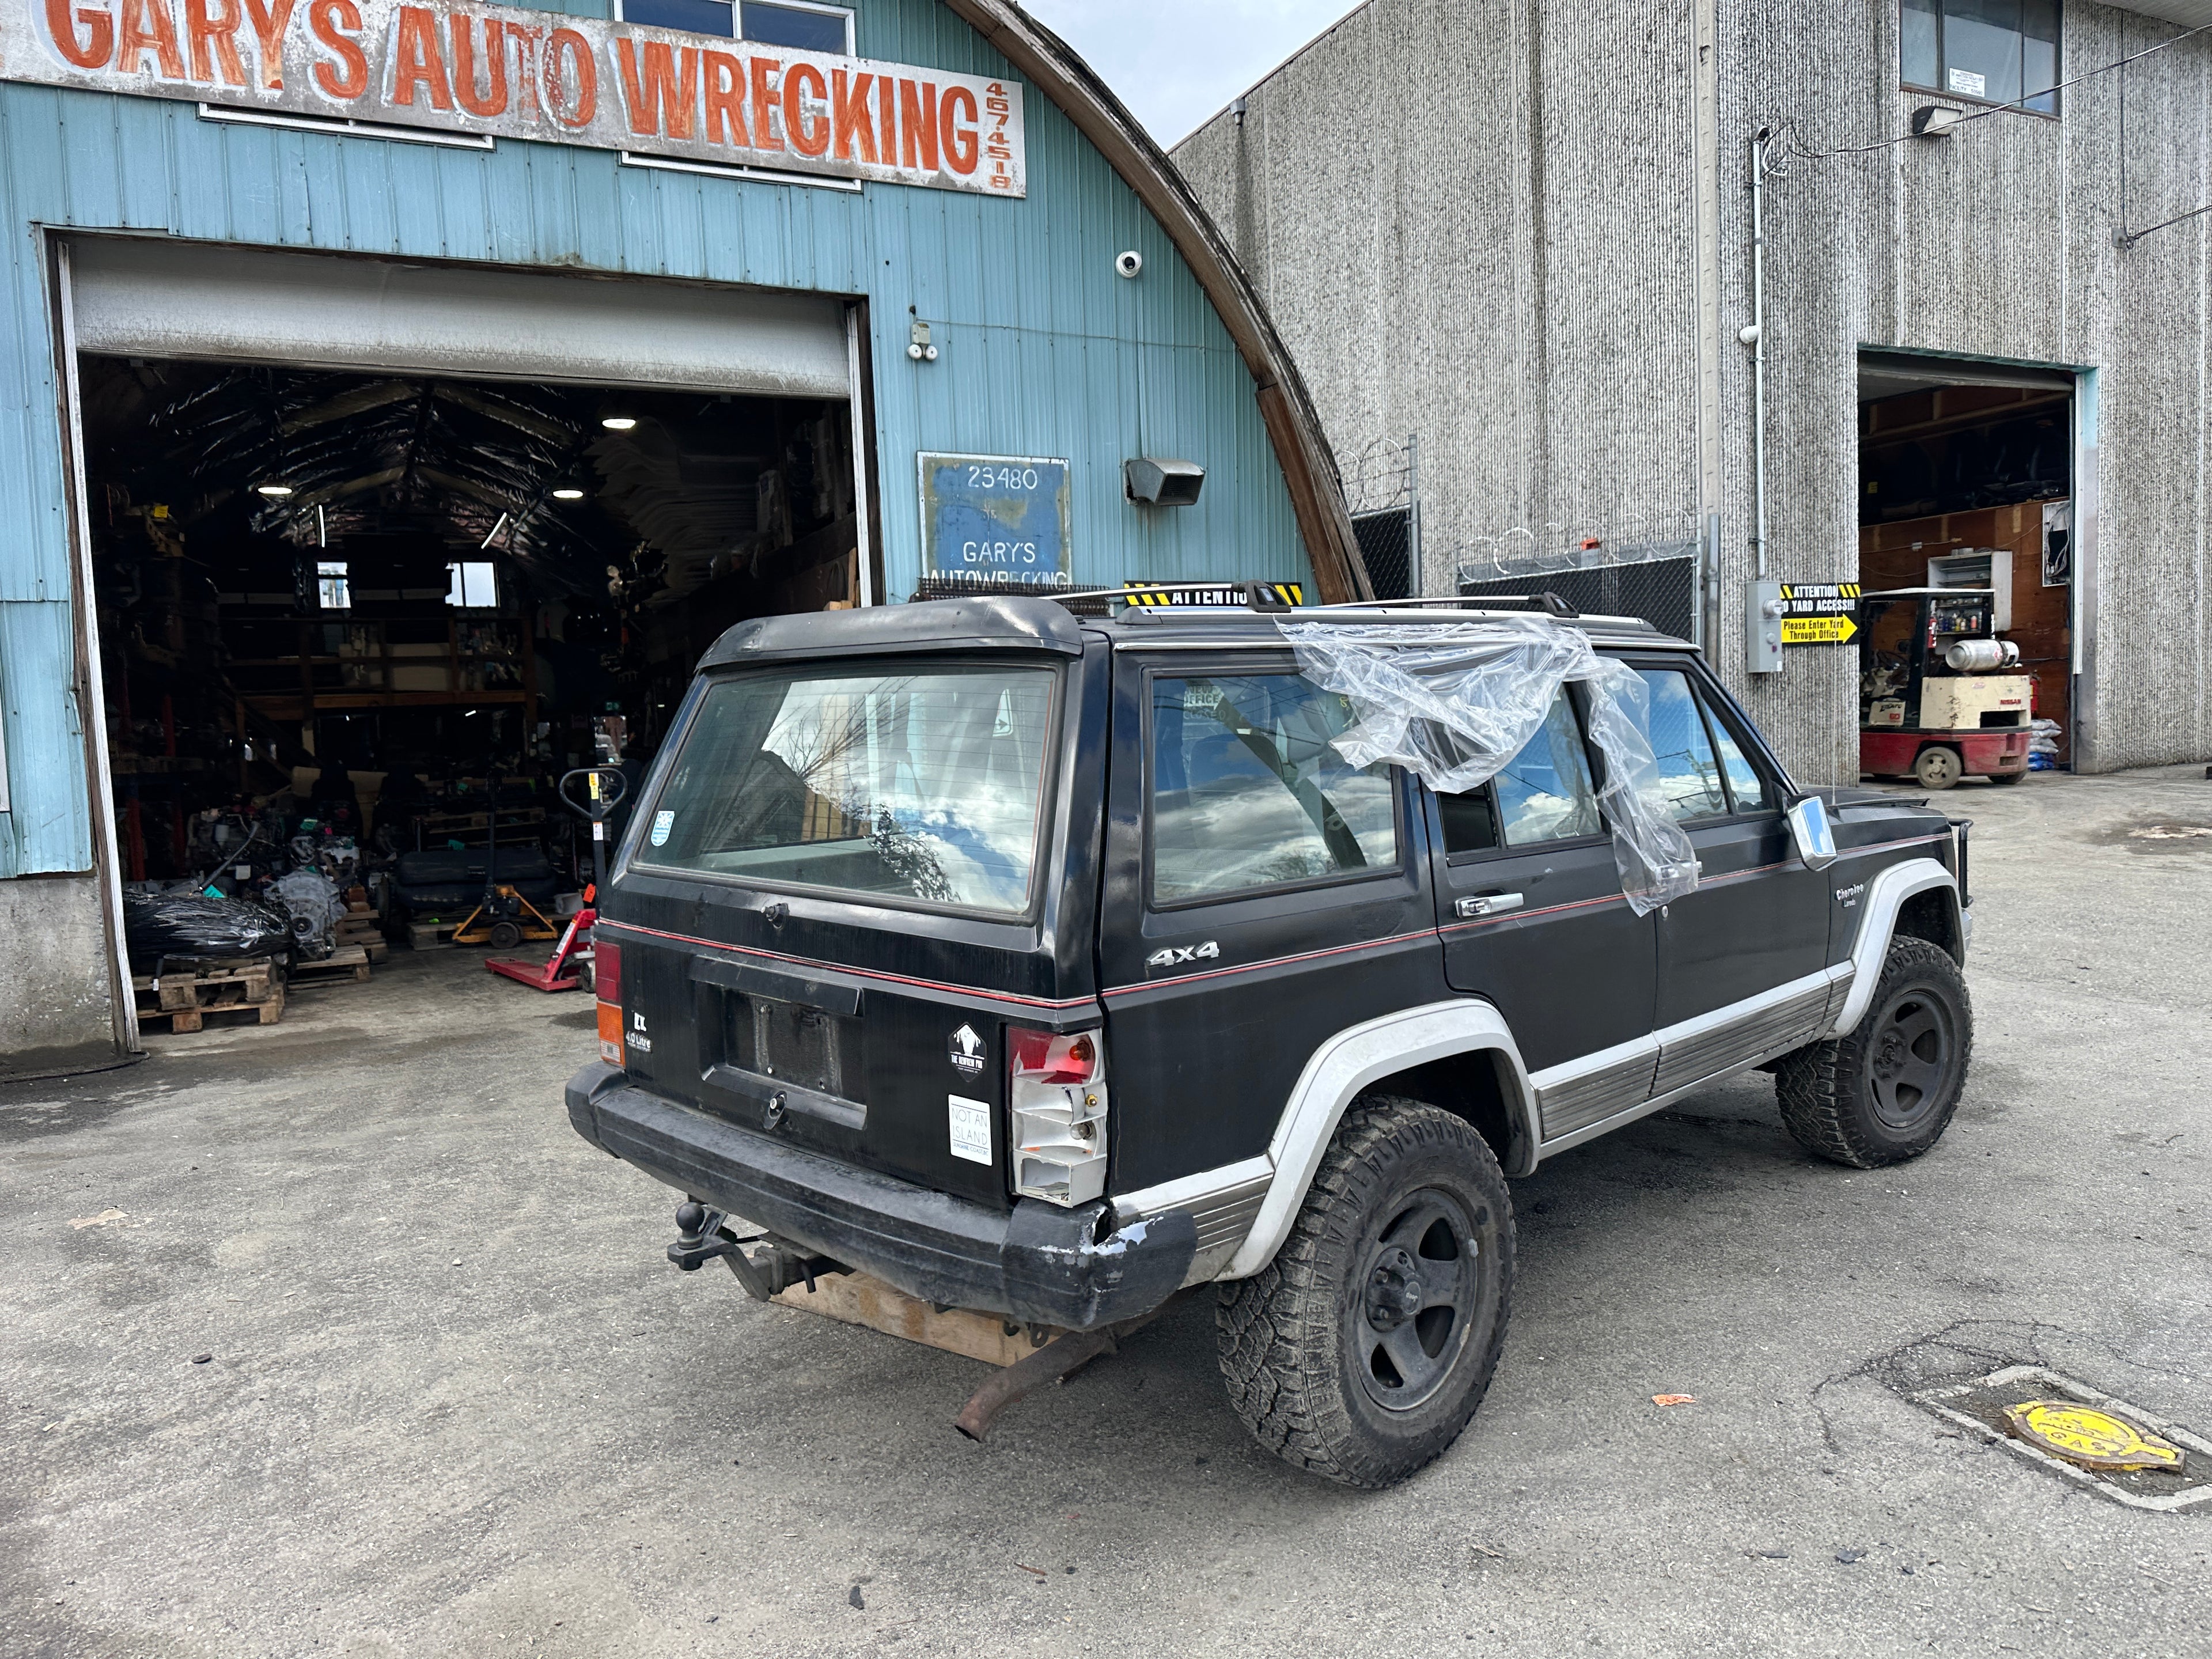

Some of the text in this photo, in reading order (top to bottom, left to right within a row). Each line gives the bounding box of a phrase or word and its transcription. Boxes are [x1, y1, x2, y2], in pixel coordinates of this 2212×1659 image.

[46, 0, 979, 175] GARYS AUTO WRECKING
[967, 466, 1038, 490] 23480
[963, 541, 1036, 564] GARY'S
[1172, 591, 1248, 605] ATTENTIO
[1793, 585, 1839, 598] ATTENTION
[1783, 599, 1855, 612] O YARD ACCESS!!!
[1783, 619, 1844, 630] Please Enter Yard
[1789, 630, 1839, 641] Through Office
[1836, 884, 1864, 900] Cherokee
[626, 1031, 635, 1043] 4.0
[636, 1035, 651, 1048] Litre
[952, 1107, 987, 1128] NOT AN
[953, 1125, 987, 1145] ISLAND
[2051, 1431, 2107, 1450] GAS
